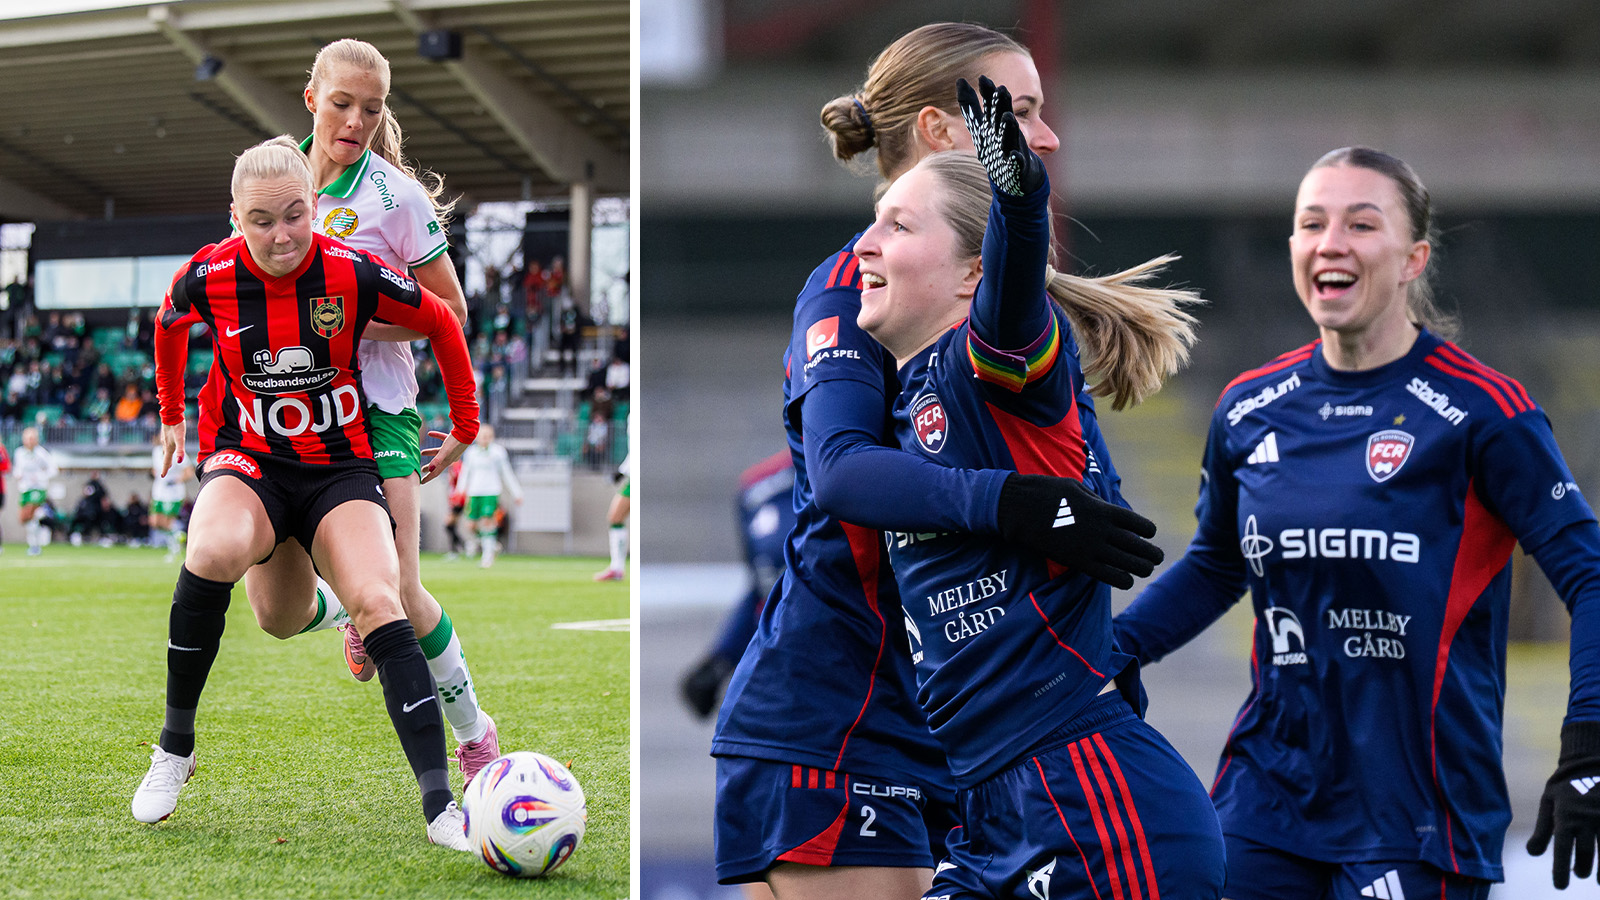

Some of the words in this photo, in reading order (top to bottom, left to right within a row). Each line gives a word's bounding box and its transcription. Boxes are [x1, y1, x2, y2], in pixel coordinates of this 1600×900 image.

[370, 170, 399, 211] Convini
[207, 259, 234, 273] Heba
[832, 350, 860, 359] SPEL
[246, 370, 335, 388] bredbandsval.se
[1226, 372, 1301, 427] stadium
[1405, 376, 1467, 427] stadium
[916, 405, 943, 432] FCR
[374, 450, 402, 459] CRAFT
[1371, 442, 1406, 458] FCR
[927, 569, 1008, 617] MELLBY
[944, 606, 1005, 643] GÅRD
[1328, 608, 1412, 636] MELLBY
[912, 650, 924, 665] SON
[1343, 632, 1406, 660] GÅRD
[859, 805, 877, 837] 2
